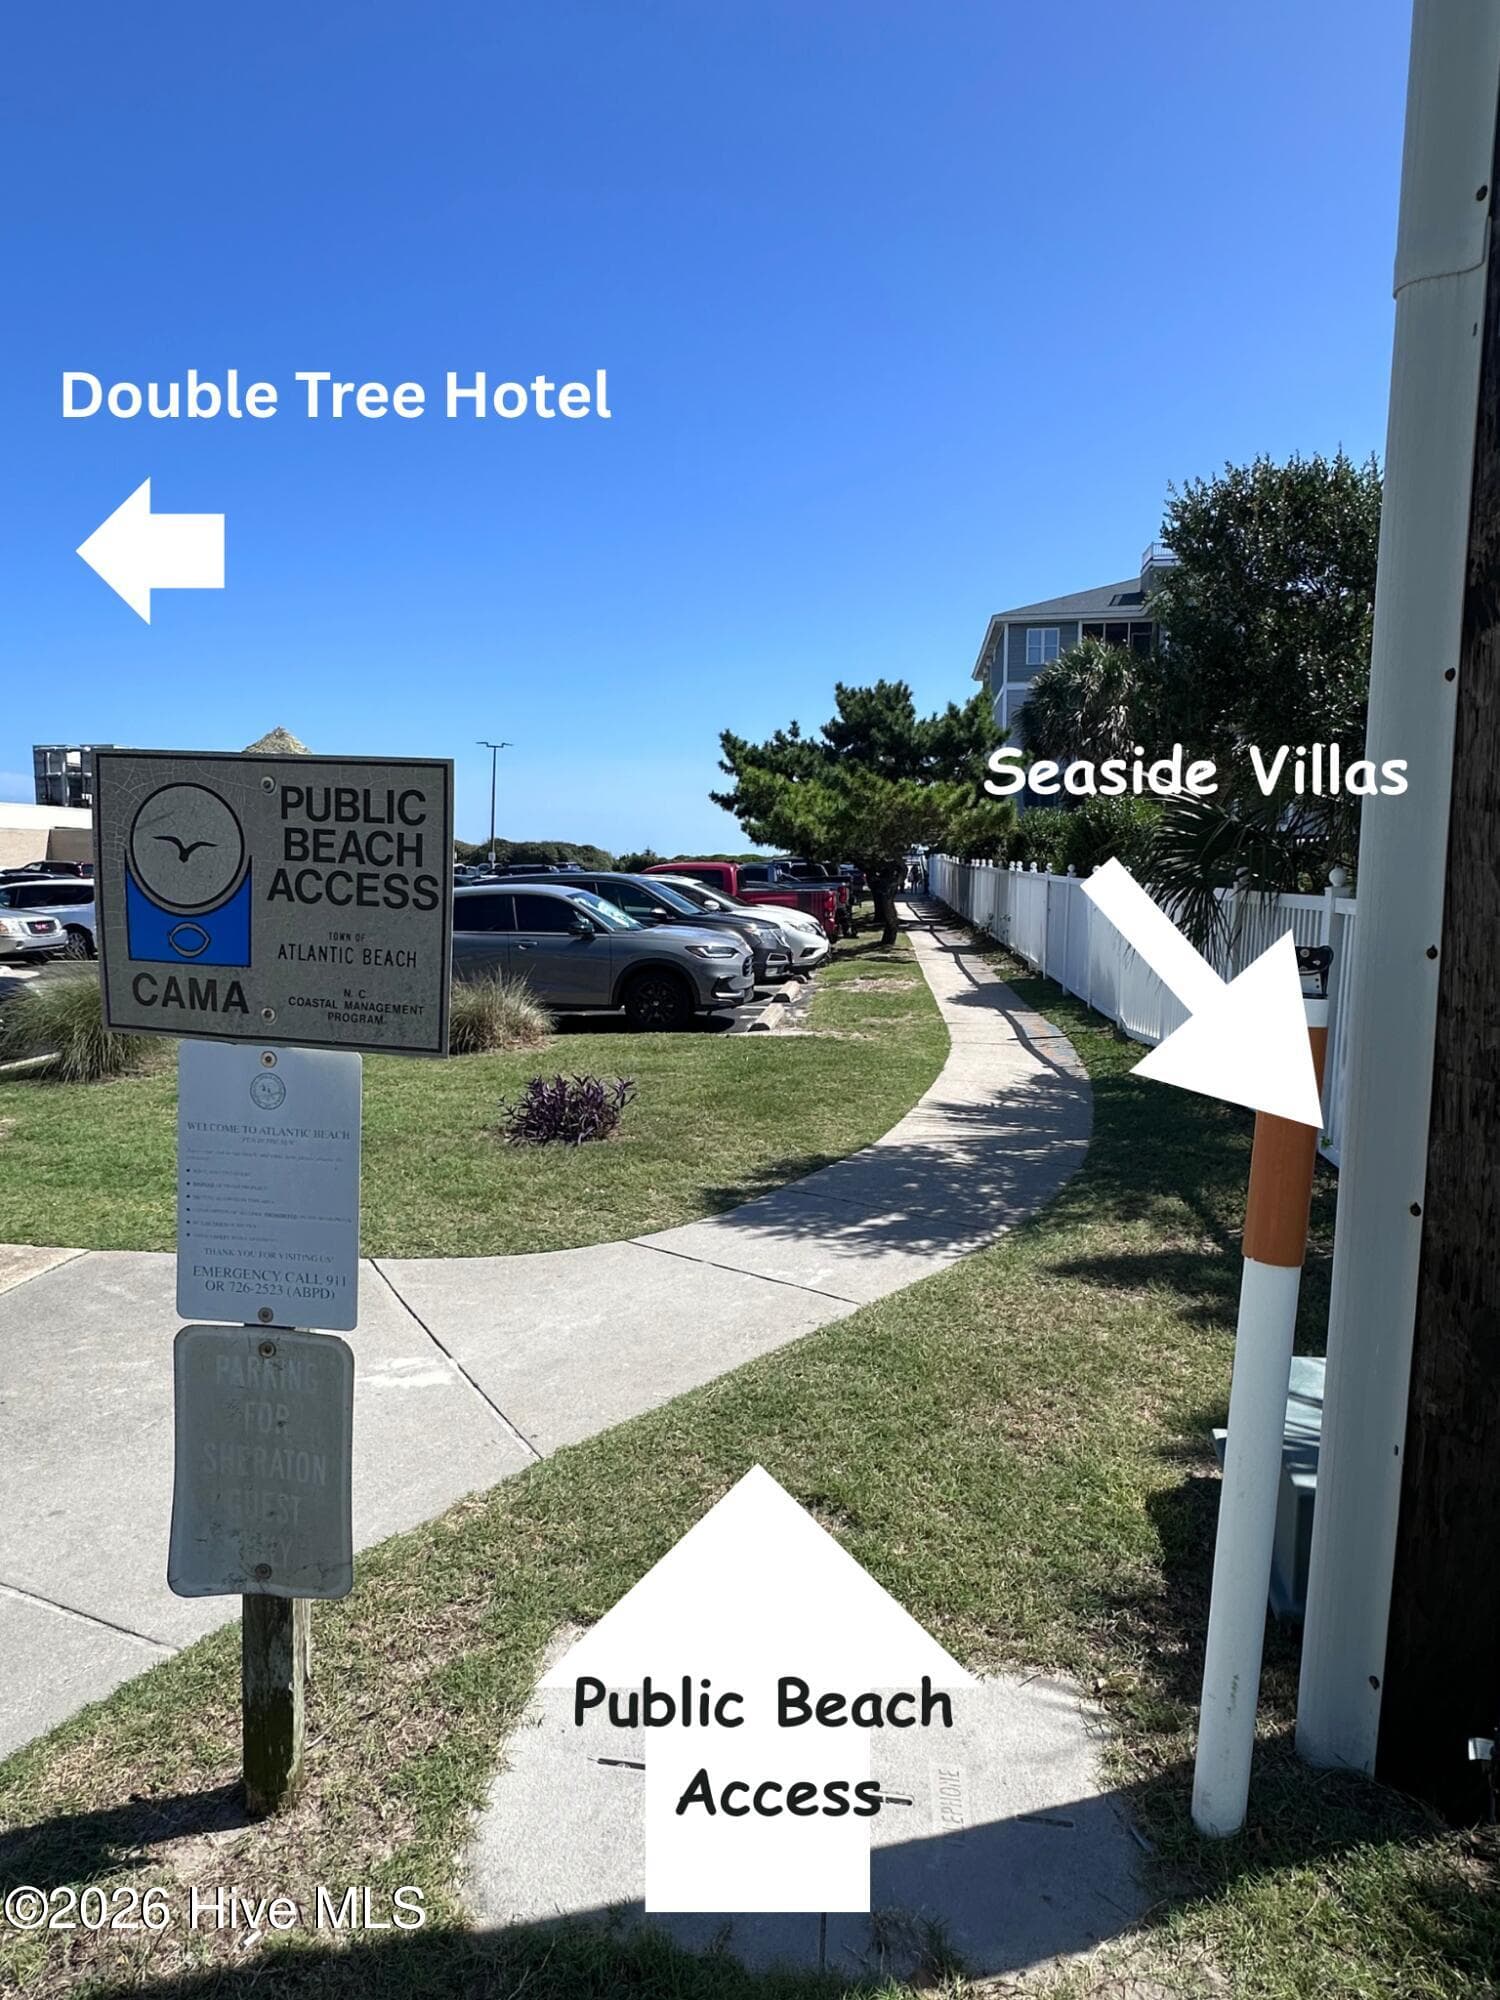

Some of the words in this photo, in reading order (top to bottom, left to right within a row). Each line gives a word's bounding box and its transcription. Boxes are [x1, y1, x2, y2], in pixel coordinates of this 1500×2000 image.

[280, 785, 427, 826] PUBLIC
[284, 827, 423, 868] BEACH
[267, 868, 439, 911] ACCESS
[328, 931, 351, 941] TOWN
[355, 932, 367, 942] OF
[278, 943, 354, 964] ATLANTIC
[362, 948, 417, 968] BEACH
[132, 972, 250, 1015] CAMA
[288, 996, 338, 1009] COASTAL
[344, 1001, 424, 1015] MANAGEMENT
[187, 1121, 241, 1134] WELCOME
[242, 1125, 257, 1135] TO
[259, 1126, 312, 1138] ATLANTIC
[313, 1129, 351, 1140] BEACH
[204, 1247, 234, 1257] THANK
[237, 1249, 257, 1258] YOU
[257, 1251, 277, 1260] FOR
[278, 1252, 318, 1263] VISITING
[205, 1280, 225, 1292] OR
[229, 1281, 283, 1296] 726-2523
[286, 1285, 335, 1300] (ABPD)
[285, 1272, 322, 1286] CALL
[326, 1275, 347, 1287] 911
[215, 1354, 319, 1394] PARKING
[244, 1401, 292, 1436] FOR
[202, 1442, 328, 1486] SHERATON
